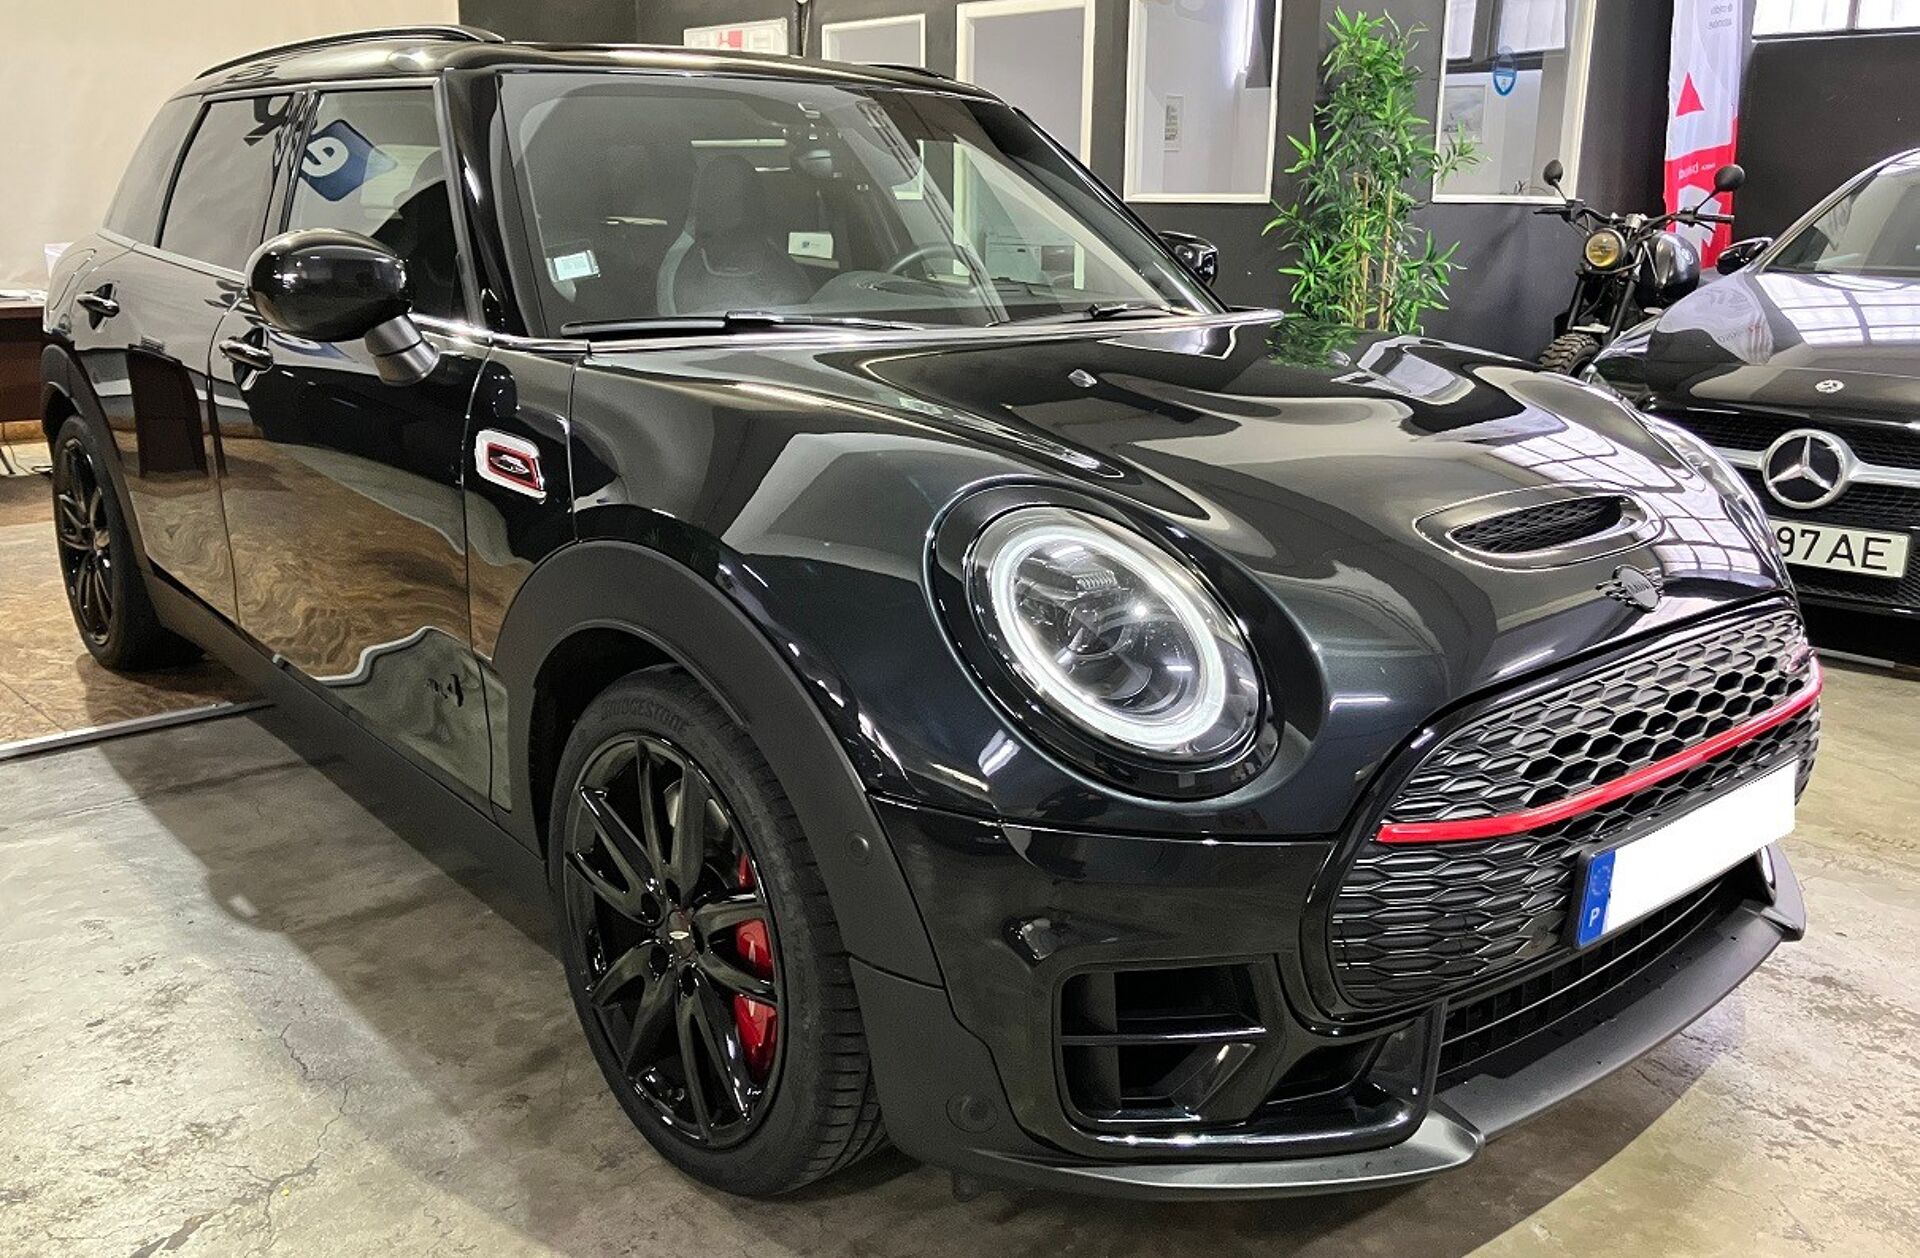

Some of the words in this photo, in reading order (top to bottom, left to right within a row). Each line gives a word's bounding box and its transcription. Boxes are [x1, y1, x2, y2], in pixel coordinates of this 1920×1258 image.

[1777, 526, 1821, 561] 97
[1826, 534, 1892, 571] AE
[1588, 906, 1600, 928] P
